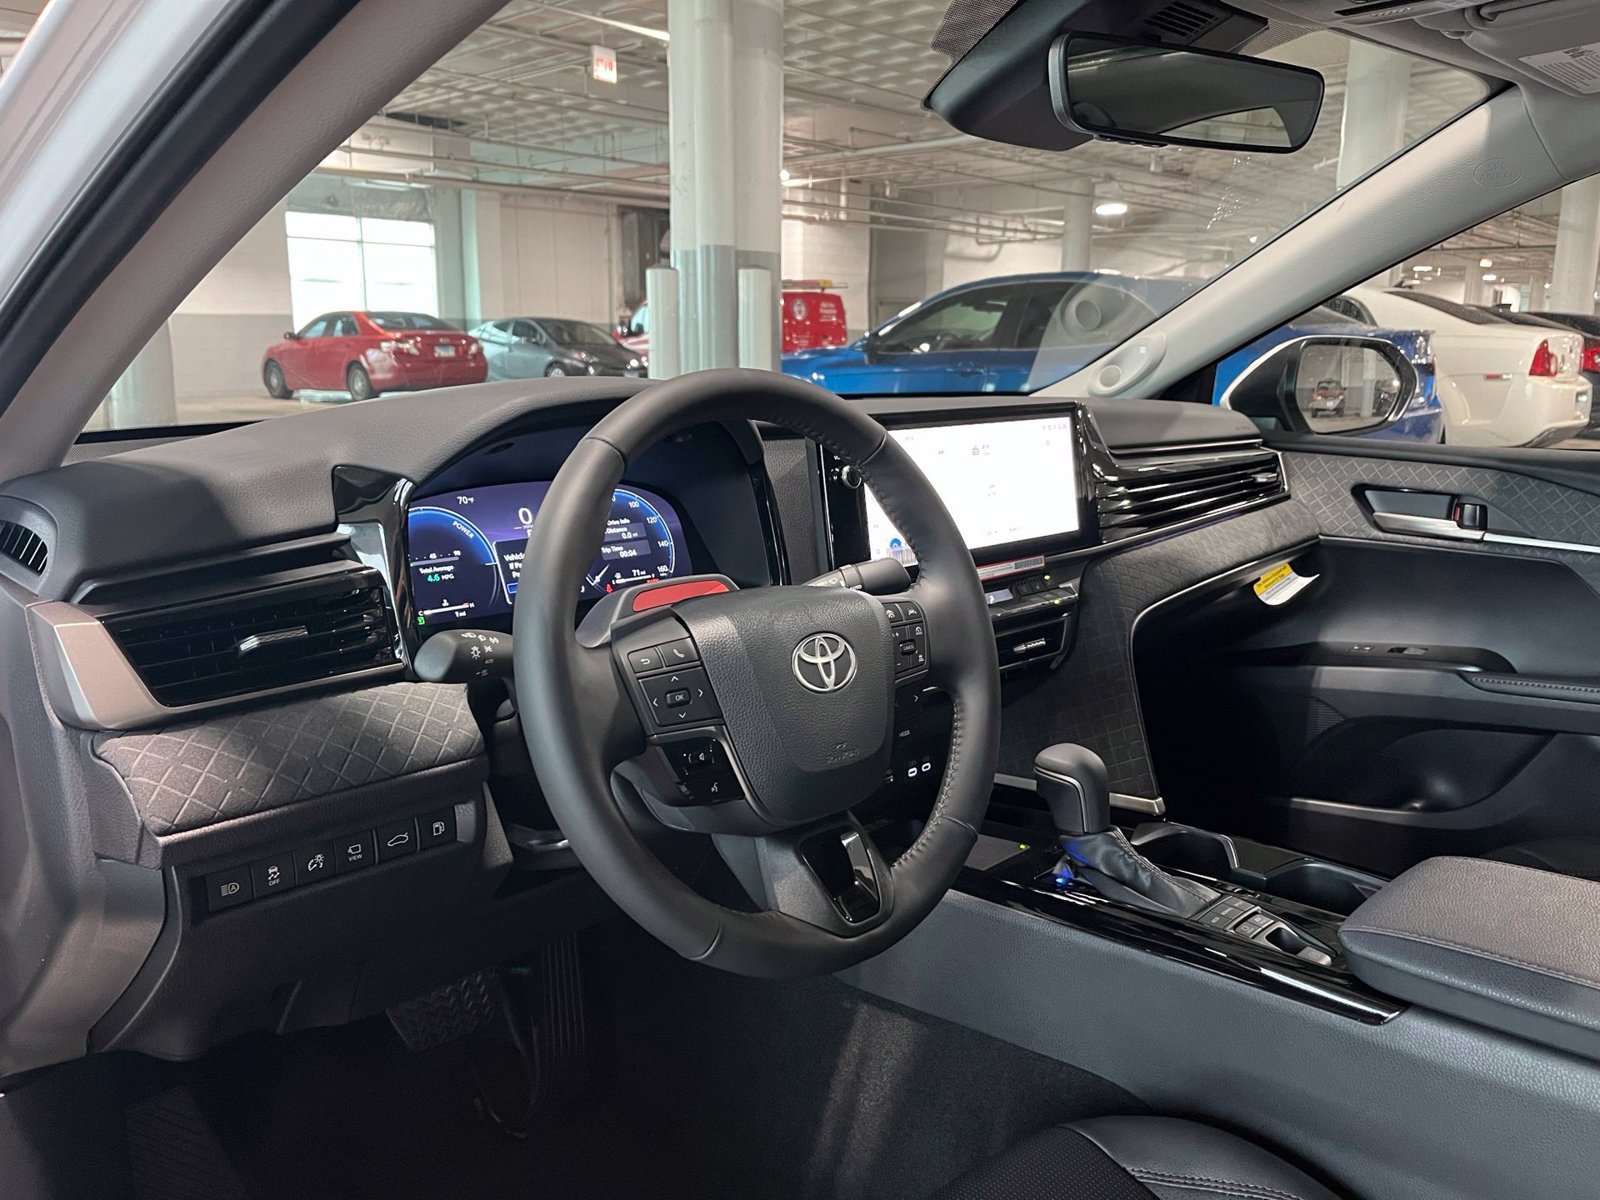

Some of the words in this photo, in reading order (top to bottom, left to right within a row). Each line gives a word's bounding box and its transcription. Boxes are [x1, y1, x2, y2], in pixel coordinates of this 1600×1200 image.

[518, 507, 532, 525] 0
[453, 521, 475, 539] POWER
[621, 531, 632, 539] 0.0
[620, 549, 638, 558] 00:04
[427, 573, 440, 582] 4.6
[348, 854, 363, 862] VIEW
[268, 879, 280, 887] OFF
